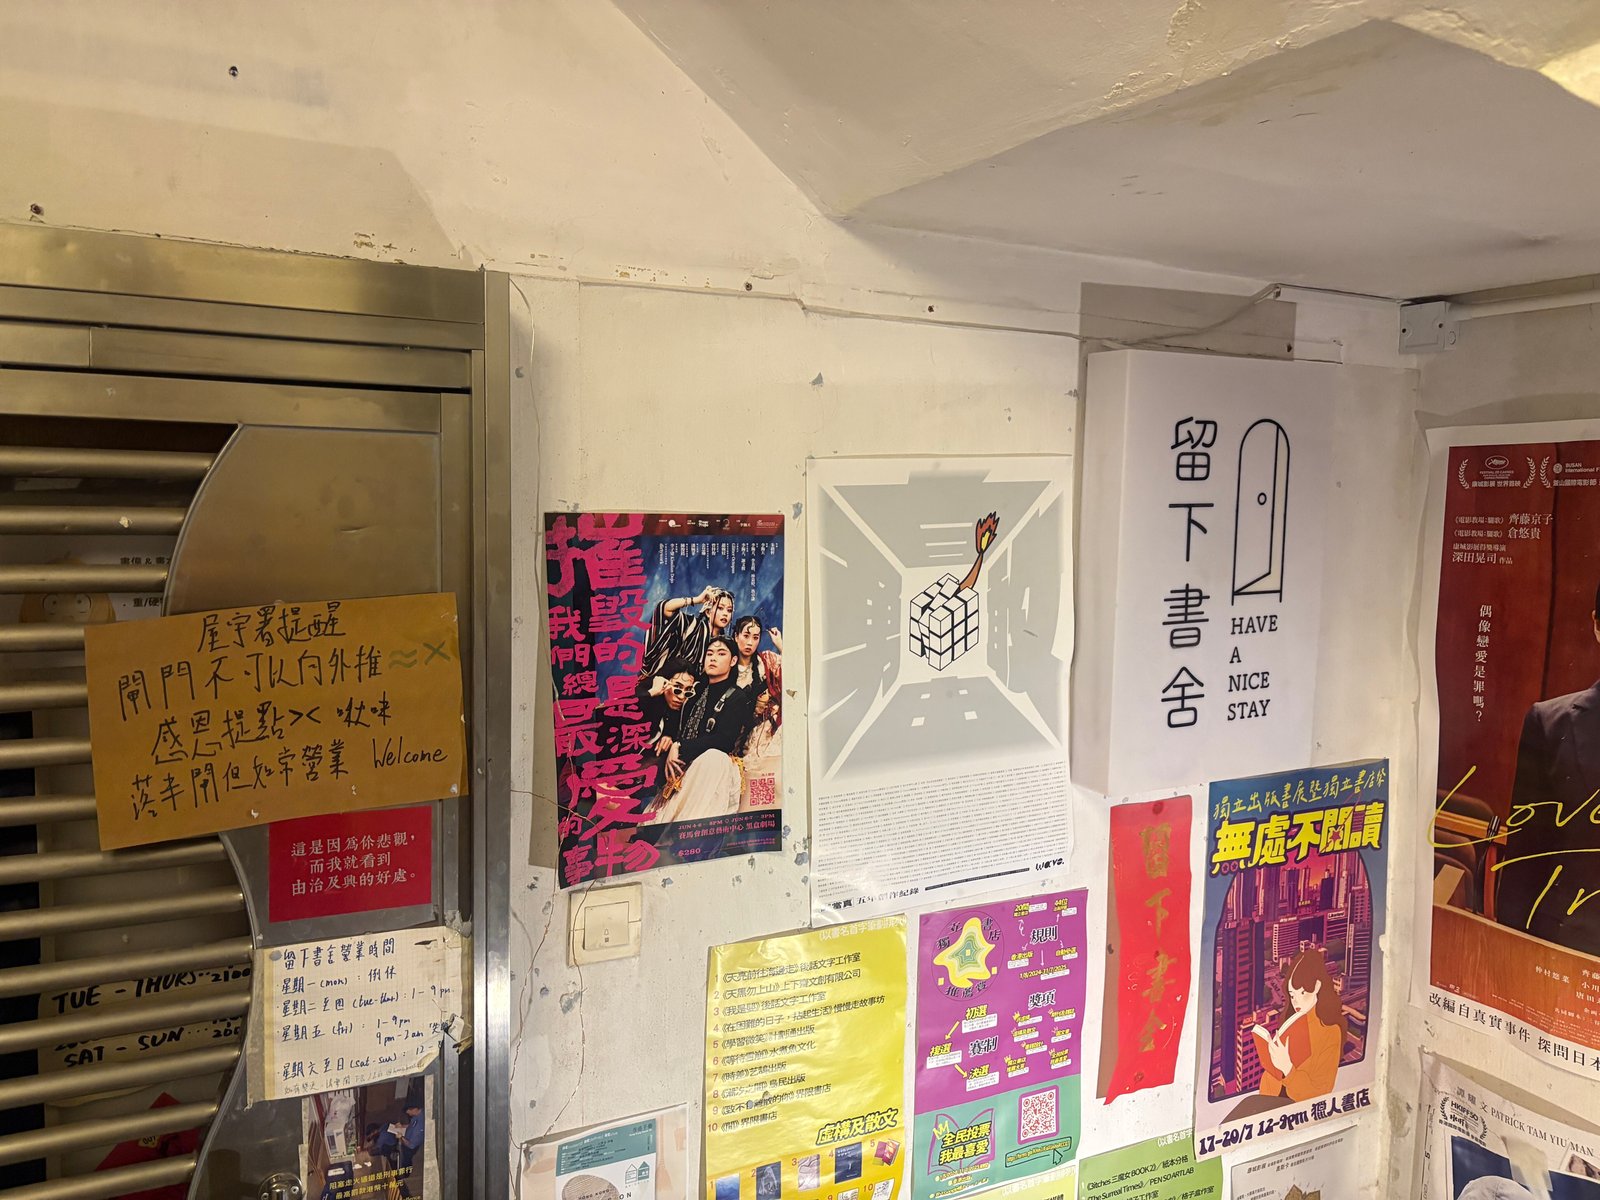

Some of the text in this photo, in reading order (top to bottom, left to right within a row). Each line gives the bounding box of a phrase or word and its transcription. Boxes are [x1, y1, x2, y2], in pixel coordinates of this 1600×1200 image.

[1161, 416, 1218, 729] 留下書舍
[198, 601, 347, 654] 屋宇署提醒
[1230, 615, 1279, 635] HAVE
[1229, 646, 1242, 664] A
[1228, 672, 1270, 693] NICE
[1227, 700, 1271, 722] STAY
[371, 736, 449, 770] Welcome
[310, 852, 390, 874] 而我就看到
[1030, 925, 1059, 945] 規則
[284, 937, 395, 970] 留下書舍營業時間
[368, 966, 397, 981] 例休
[52, 985, 101, 1014] TUE
[1429, 992, 1531, 1043] 改編自真實事件
[1538, 1036, 1600, 1071] 探問日本
[64, 1045, 104, 1068] SAT
[137, 1026, 185, 1051] SUN
[816, 1108, 898, 1147] 虛構及散文
[942, 1121, 992, 1148] 全民投票
[1199, 1123, 1254, 1155] 17-20/7
[1257, 1110, 1309, 1137] 12-9pm
[1311, 1087, 1370, 1122] 獵人書店
[1491, 1107, 1525, 1133] PATRICK
[1527, 1125, 1547, 1141] TAM
[1550, 1134, 1567, 1148] YIU
[1570, 1141, 1595, 1157] MAN
[939, 1139, 989, 1165] 我最喜愛
